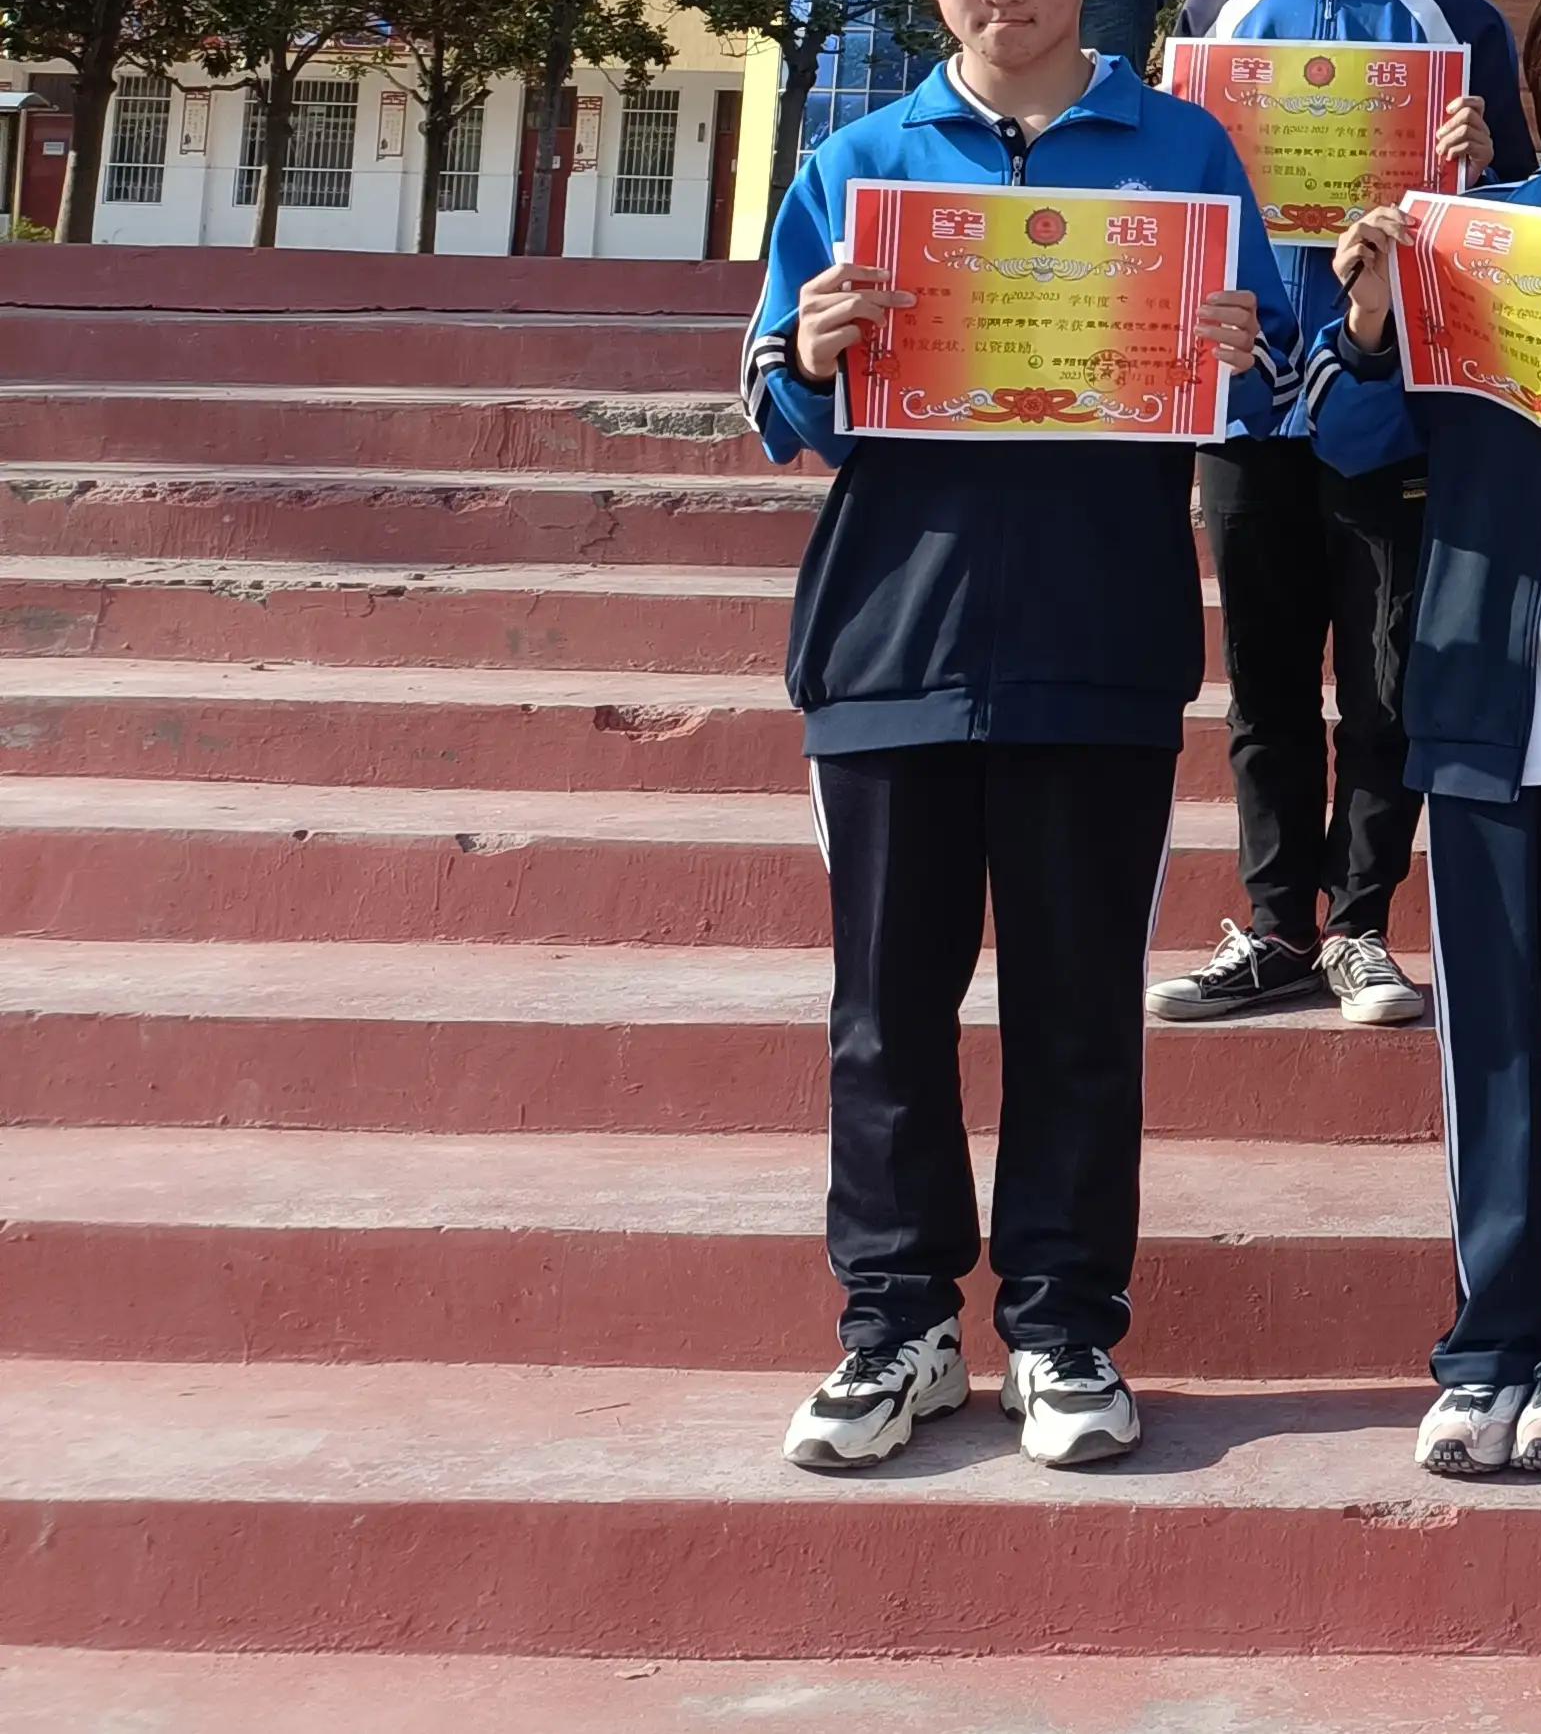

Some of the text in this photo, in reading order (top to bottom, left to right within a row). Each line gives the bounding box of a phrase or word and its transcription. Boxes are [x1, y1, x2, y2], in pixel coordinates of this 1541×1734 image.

[1231, 57, 1407, 87] 奖 状
[932, 208, 1158, 246] 奖 状
[1463, 219, 1514, 255] 奖
